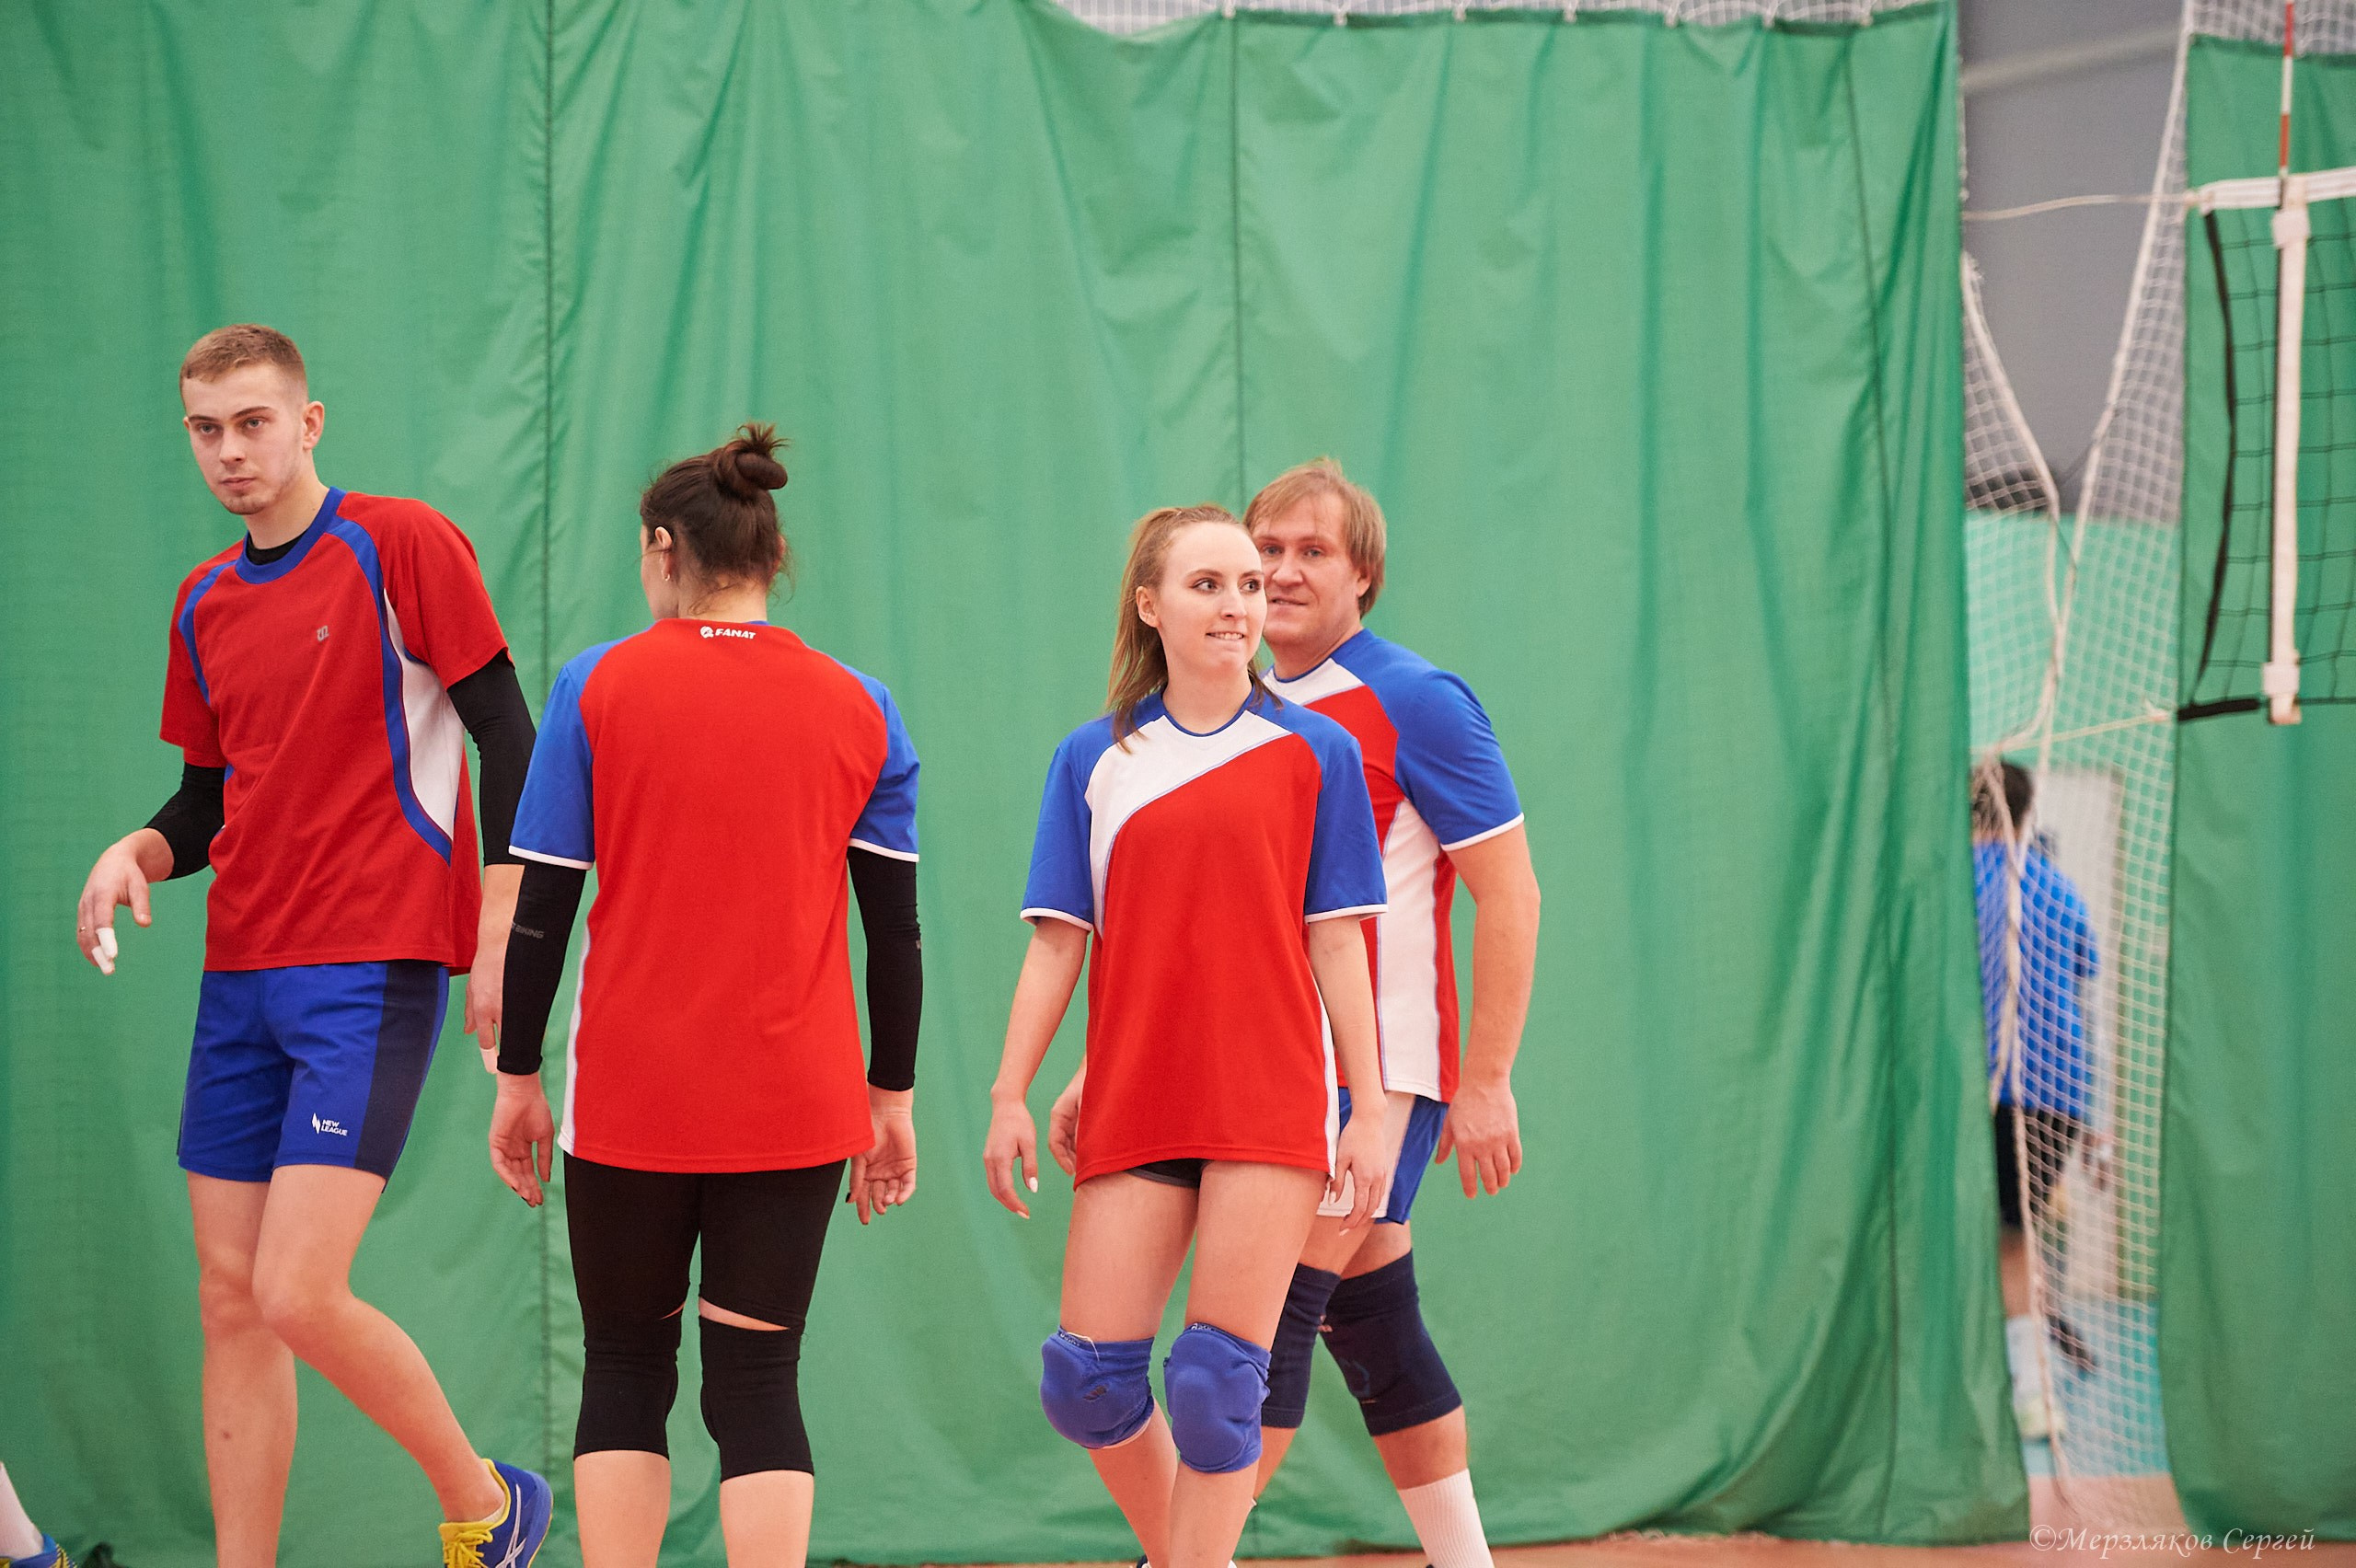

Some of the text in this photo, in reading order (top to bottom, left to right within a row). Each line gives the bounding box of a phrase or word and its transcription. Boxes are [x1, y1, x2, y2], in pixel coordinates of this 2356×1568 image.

[715, 628, 756, 640] FANAT
[322, 1119, 340, 1128] NEW
[321, 1124, 348, 1136] LEAGUE
